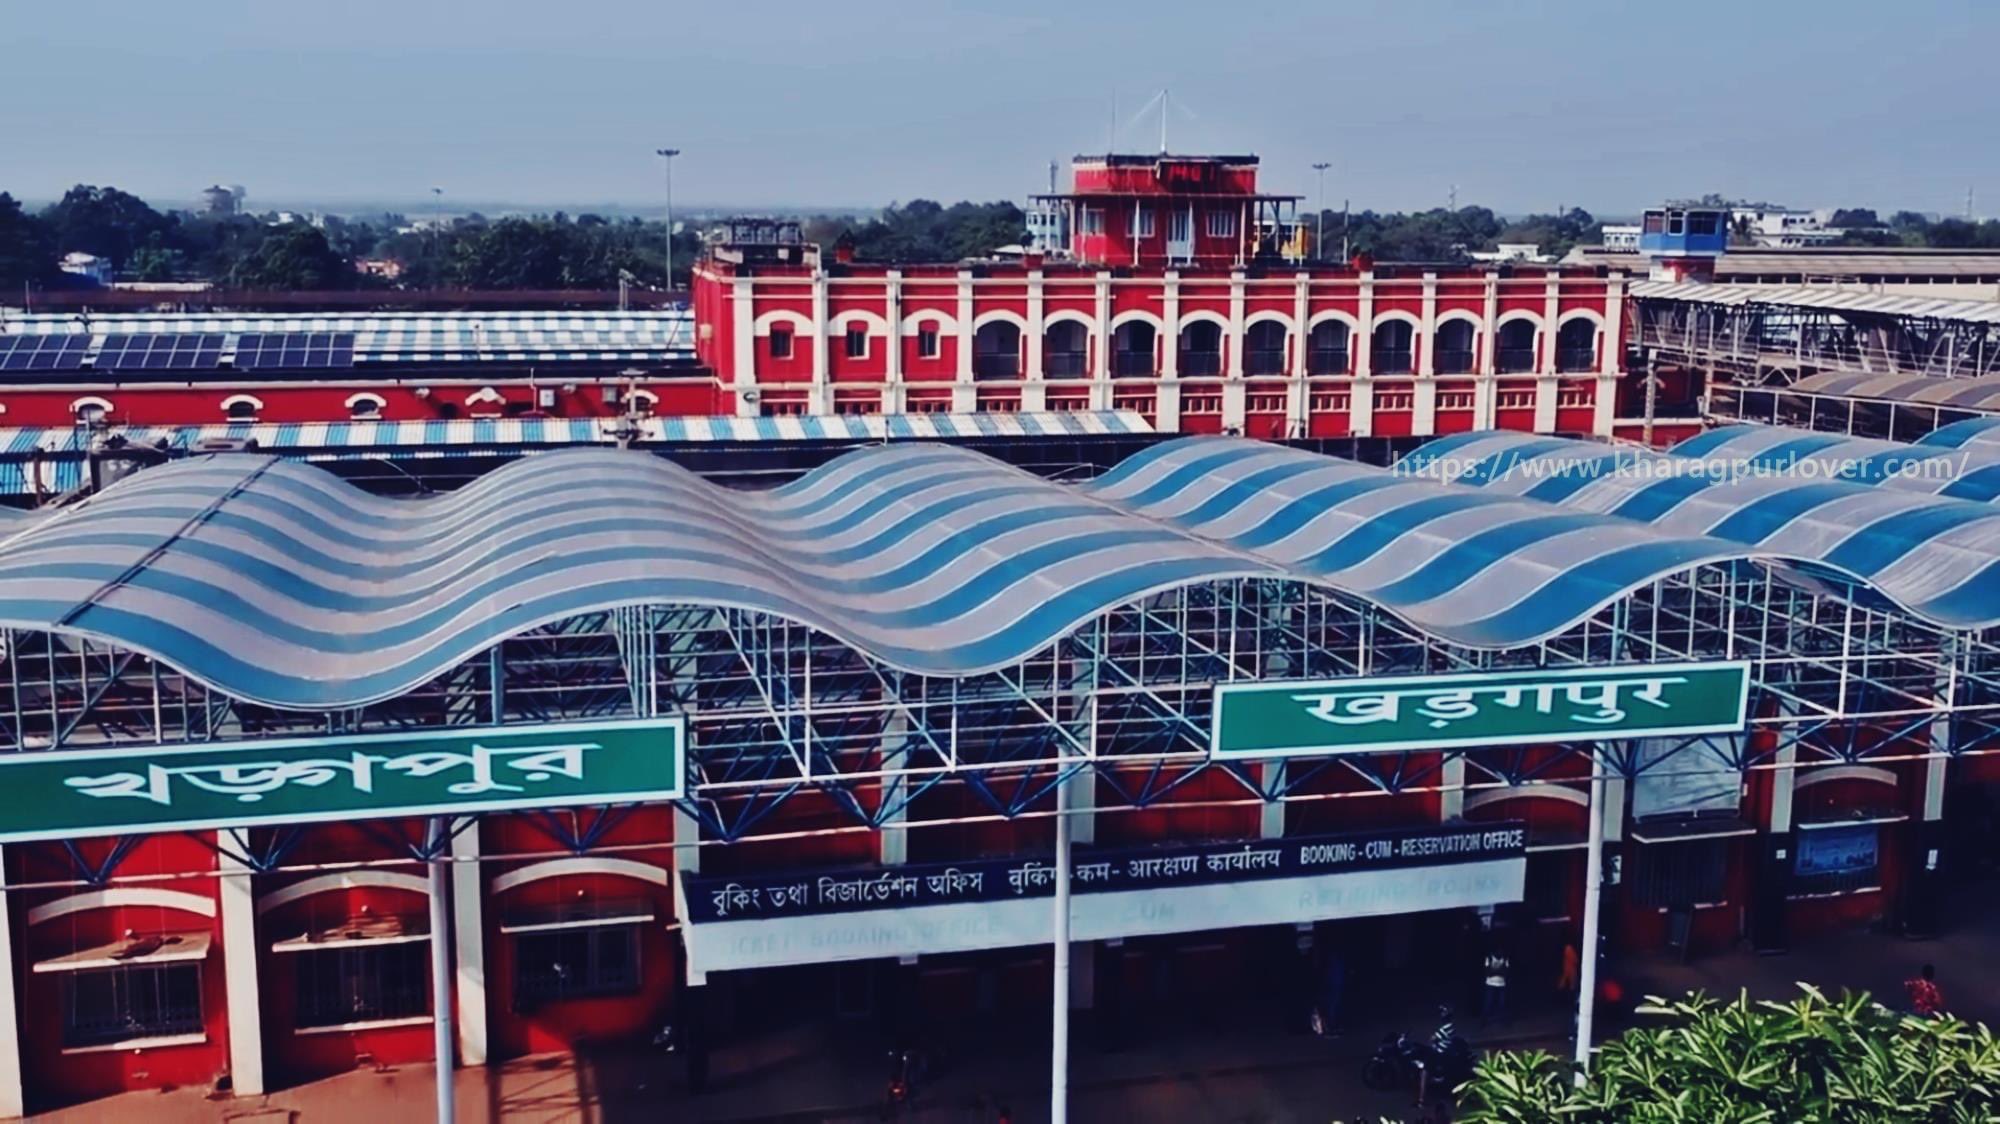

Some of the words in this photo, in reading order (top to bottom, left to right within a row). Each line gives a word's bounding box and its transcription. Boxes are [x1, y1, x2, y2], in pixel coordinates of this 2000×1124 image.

[1291, 677, 1688, 728] खड़गपुर
[1207, 845, 1282, 872] कार्यालय
[1300, 843, 1355, 864] BOOKING
[1366, 840, 1392, 859] CUM
[1401, 833, 1480, 857] RESERVATION
[1483, 830, 1524, 849] OFFICE
[711, 883, 761, 916] বুকিং
[766, 884, 809, 907] তথা
[927, 868, 983, 895] অফিস
